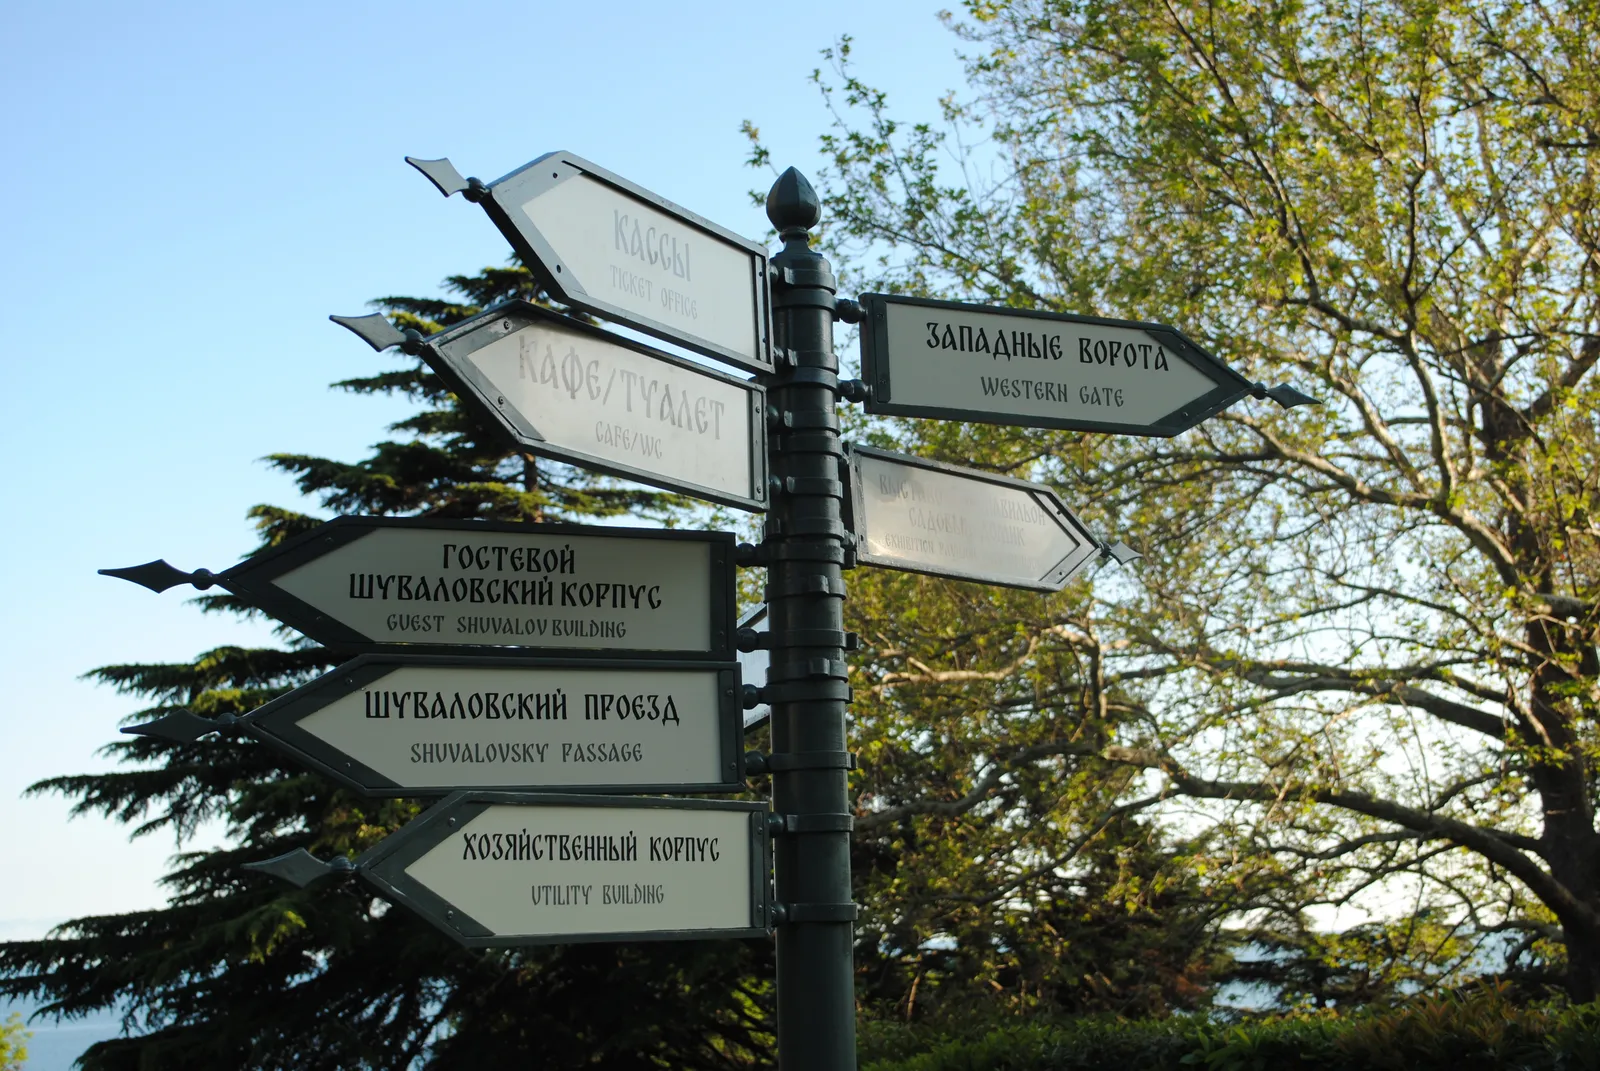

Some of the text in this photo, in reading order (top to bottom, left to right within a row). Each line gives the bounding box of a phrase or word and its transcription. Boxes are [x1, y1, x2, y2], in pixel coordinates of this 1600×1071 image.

[613, 208, 691, 282] КАССЫ
[609, 264, 698, 320] TICKET OFFICE
[926, 321, 1170, 372] ЗАПАДНЫЕ ВОРОТА
[518, 335, 725, 440] КАФЕ/ТУАЛЕТ
[980, 376, 1124, 408] WESTERN GATE
[595, 420, 663, 460] CAFE/WC
[443, 544, 575, 574] ГОСТЕВОЙ
[350, 573, 662, 610] ШУВАЛОВСКИЙ КОРПУС
[387, 613, 627, 639] GUEST SHUVALOV BUILDING
[365, 688, 680, 727] ШУВАЛОВСКИЙ ПРОЕЗД
[410, 743, 643, 763] SHUVALOVSKY PASSAGE
[463, 828, 720, 862] ХОЗЯЙСТВЕННЫЙ КОРПУС
[531, 883, 664, 905] UTILITY BUILDING
